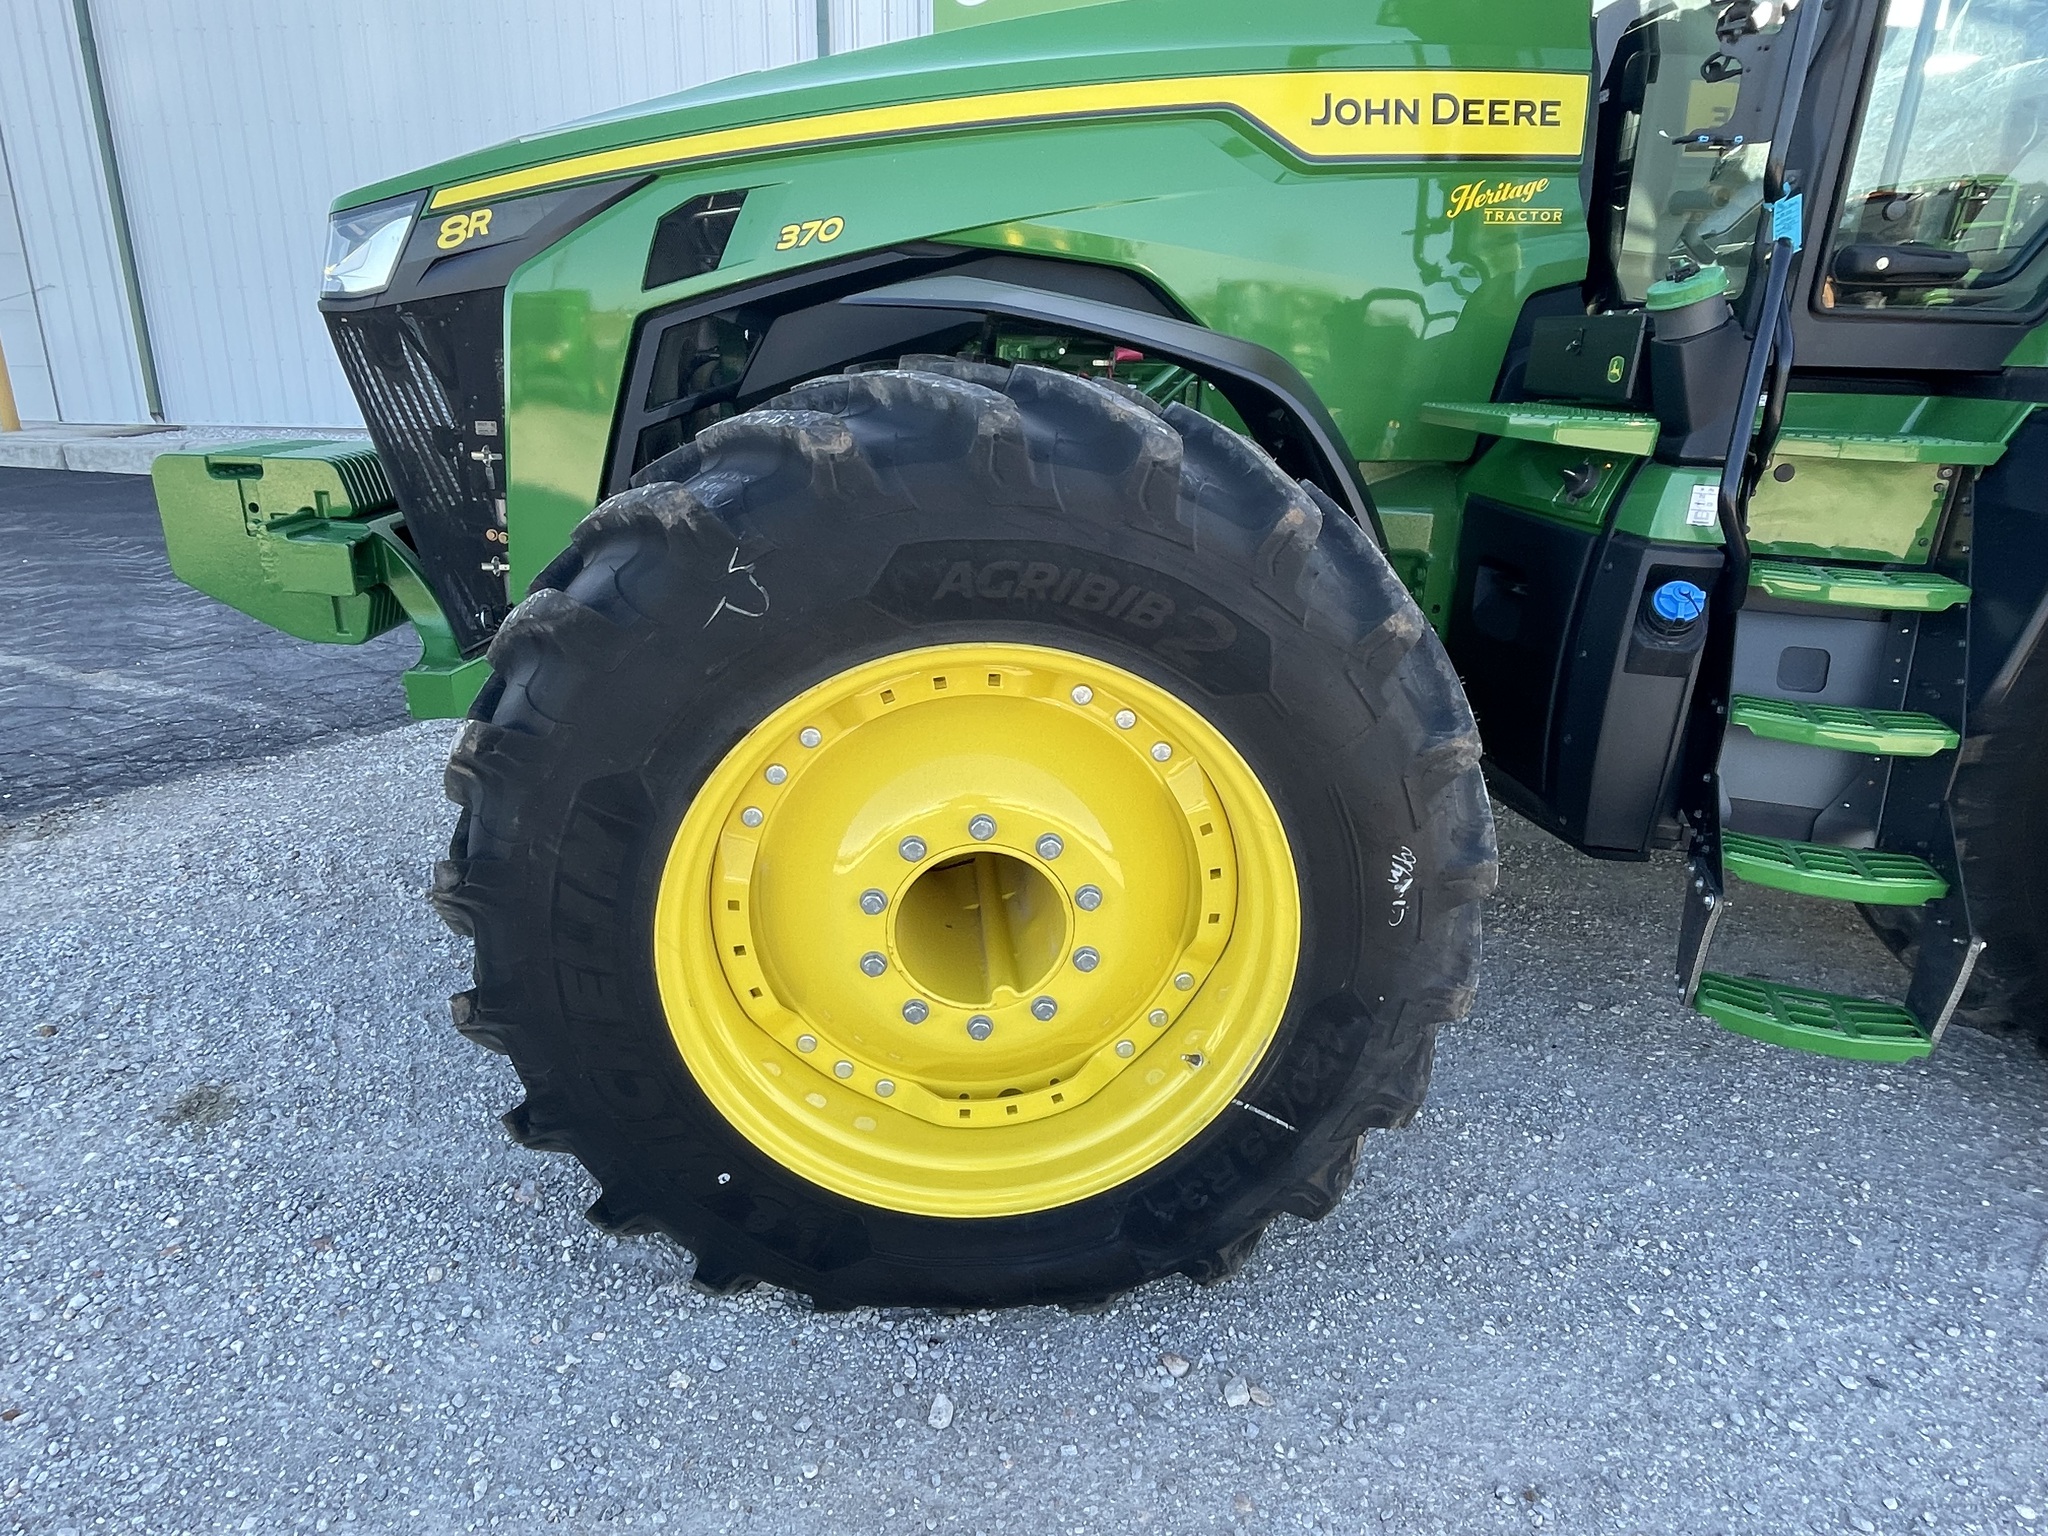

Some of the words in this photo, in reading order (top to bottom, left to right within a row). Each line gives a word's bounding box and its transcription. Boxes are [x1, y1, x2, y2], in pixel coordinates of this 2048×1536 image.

[1311, 92, 1420, 126] JOHN
[1432, 92, 1562, 127] DEERE
[1446, 178, 1550, 218] Heritage
[1484, 209, 1563, 223] TRACTOR
[437, 208, 493, 250] 8R
[775, 216, 845, 251] 370
[932, 560, 1177, 631] AGRIBIB
[1152, 606, 1238, 665] 2
